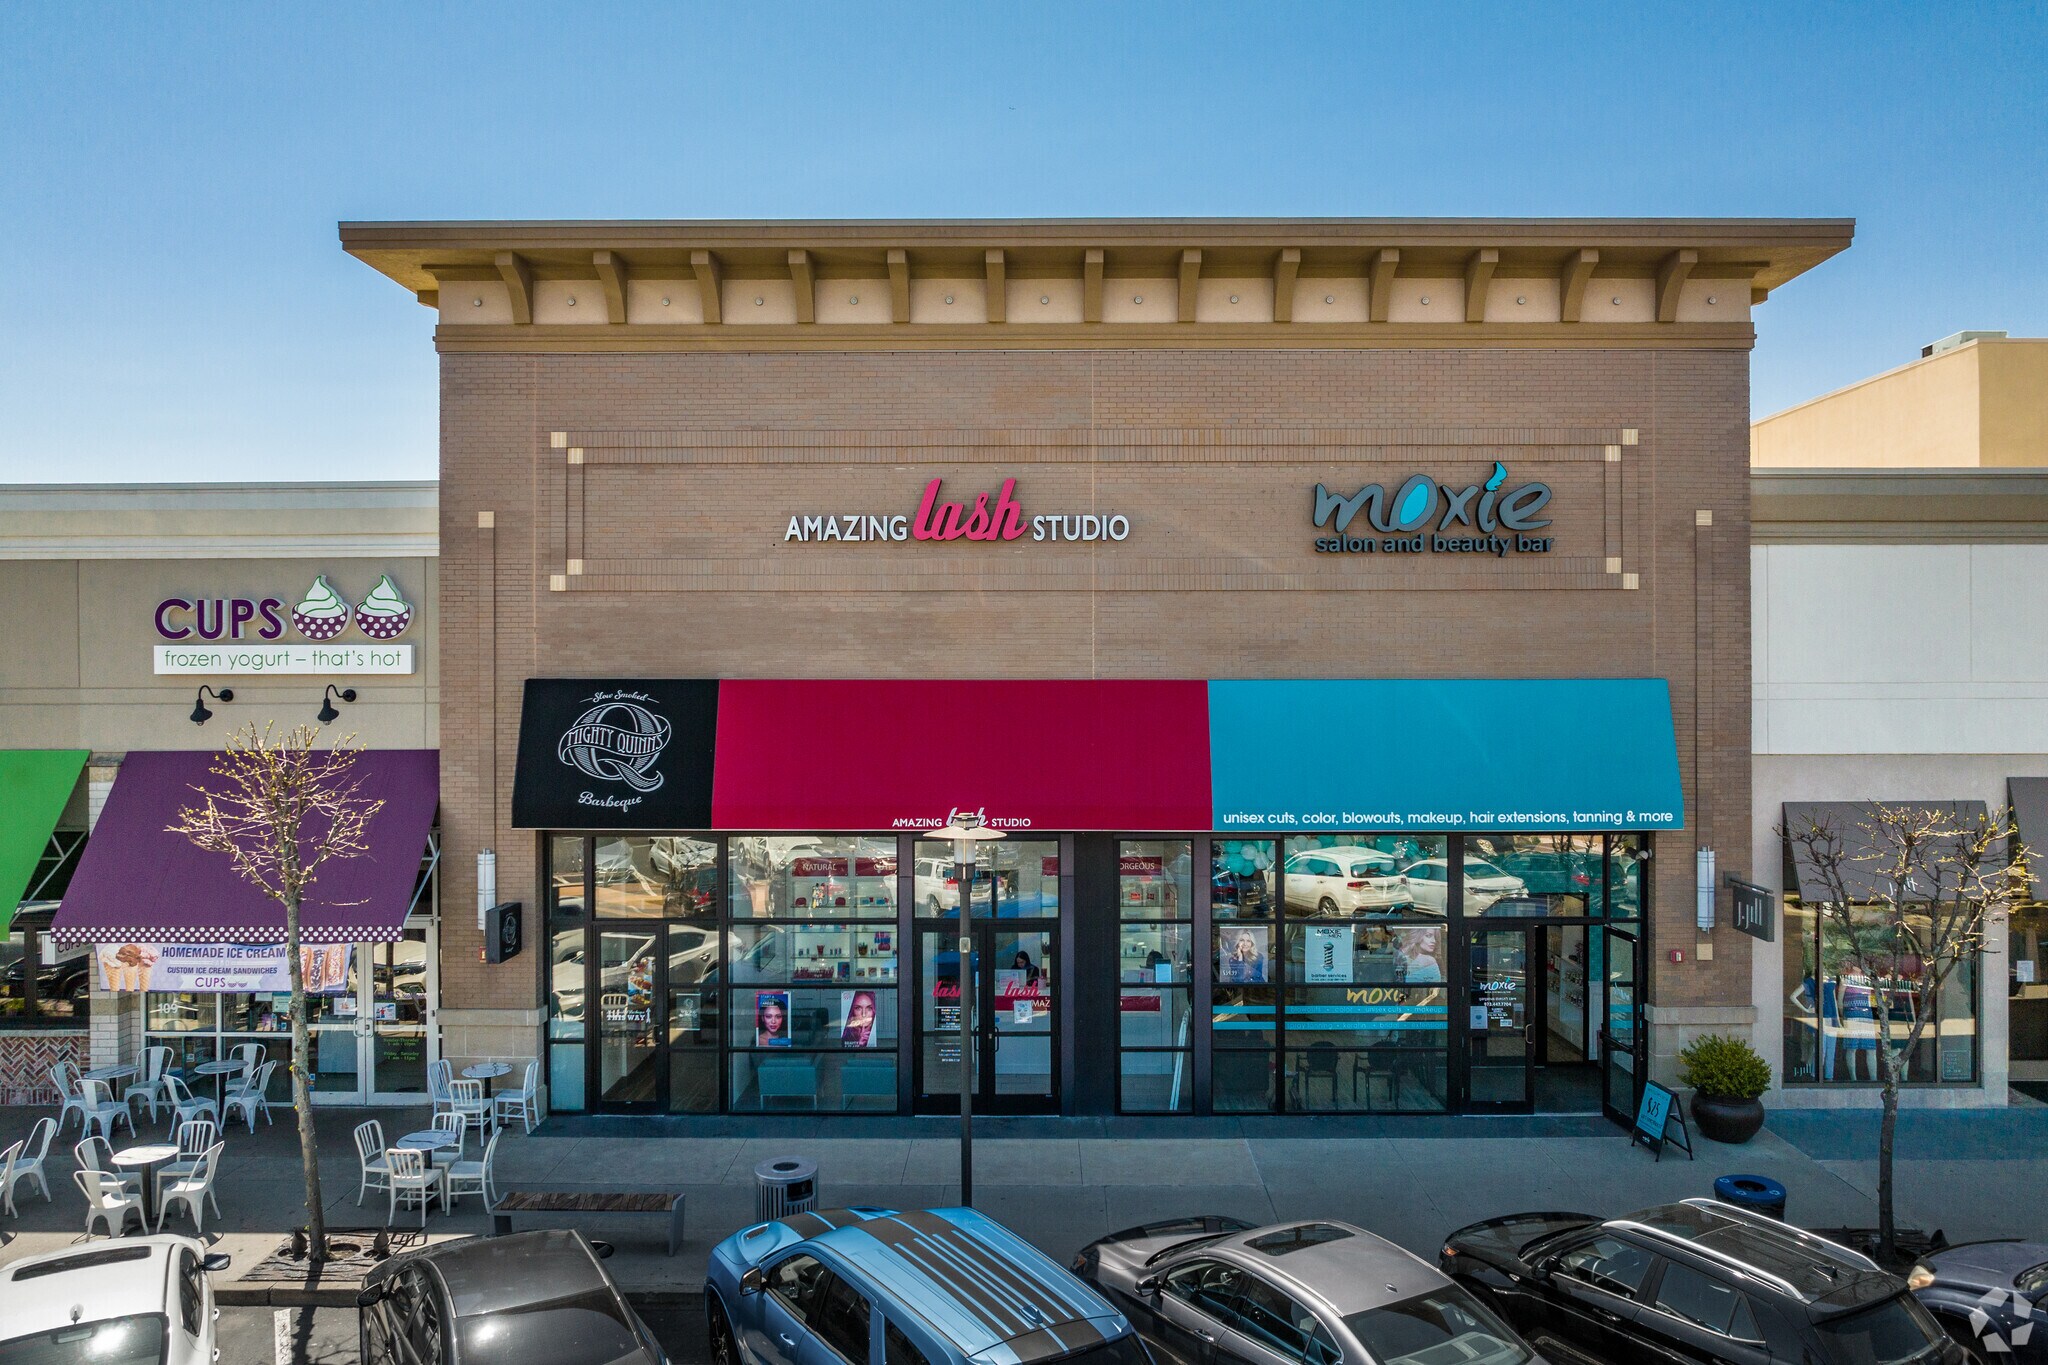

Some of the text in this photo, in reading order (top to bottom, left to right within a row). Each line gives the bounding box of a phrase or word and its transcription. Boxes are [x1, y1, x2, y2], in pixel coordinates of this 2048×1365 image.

[1313, 461, 1553, 534] moxie
[784, 478, 1131, 542] AMAZING lash STUDIO
[1315, 533, 1555, 558] salon and beauty bar
[154, 597, 287, 641] CUPS
[164, 650, 222, 667] frozen
[227, 650, 290, 671] yogurt
[312, 650, 364, 667] that's
[370, 650, 402, 667] hot
[593, 689, 649, 702] Slow Smoked
[567, 727, 663, 753] MIGHTY QUINNS
[578, 791, 642, 812] Barbeque
[891, 806, 1032, 828] AMAZING lh STUDIO
[1223, 810, 1674, 826] unisex cuts, color, blowouts, makeup, hair extensions, tanning & more
[802, 863, 836, 871] NATURAL
[1120, 862, 1155, 870] ORGEOUS
[161, 946, 287, 959] HOMEMADE ICE CREAM
[166, 966, 278, 975] CUSTOM ICE CREAM SANDWICHES
[194, 976, 227, 989] CUPS
[1003, 980, 1041, 998] lash
[1480, 976, 1516, 990] moxie
[157, 1002, 179, 1014] 109
[1414, 1006, 1443, 1014] makeup
